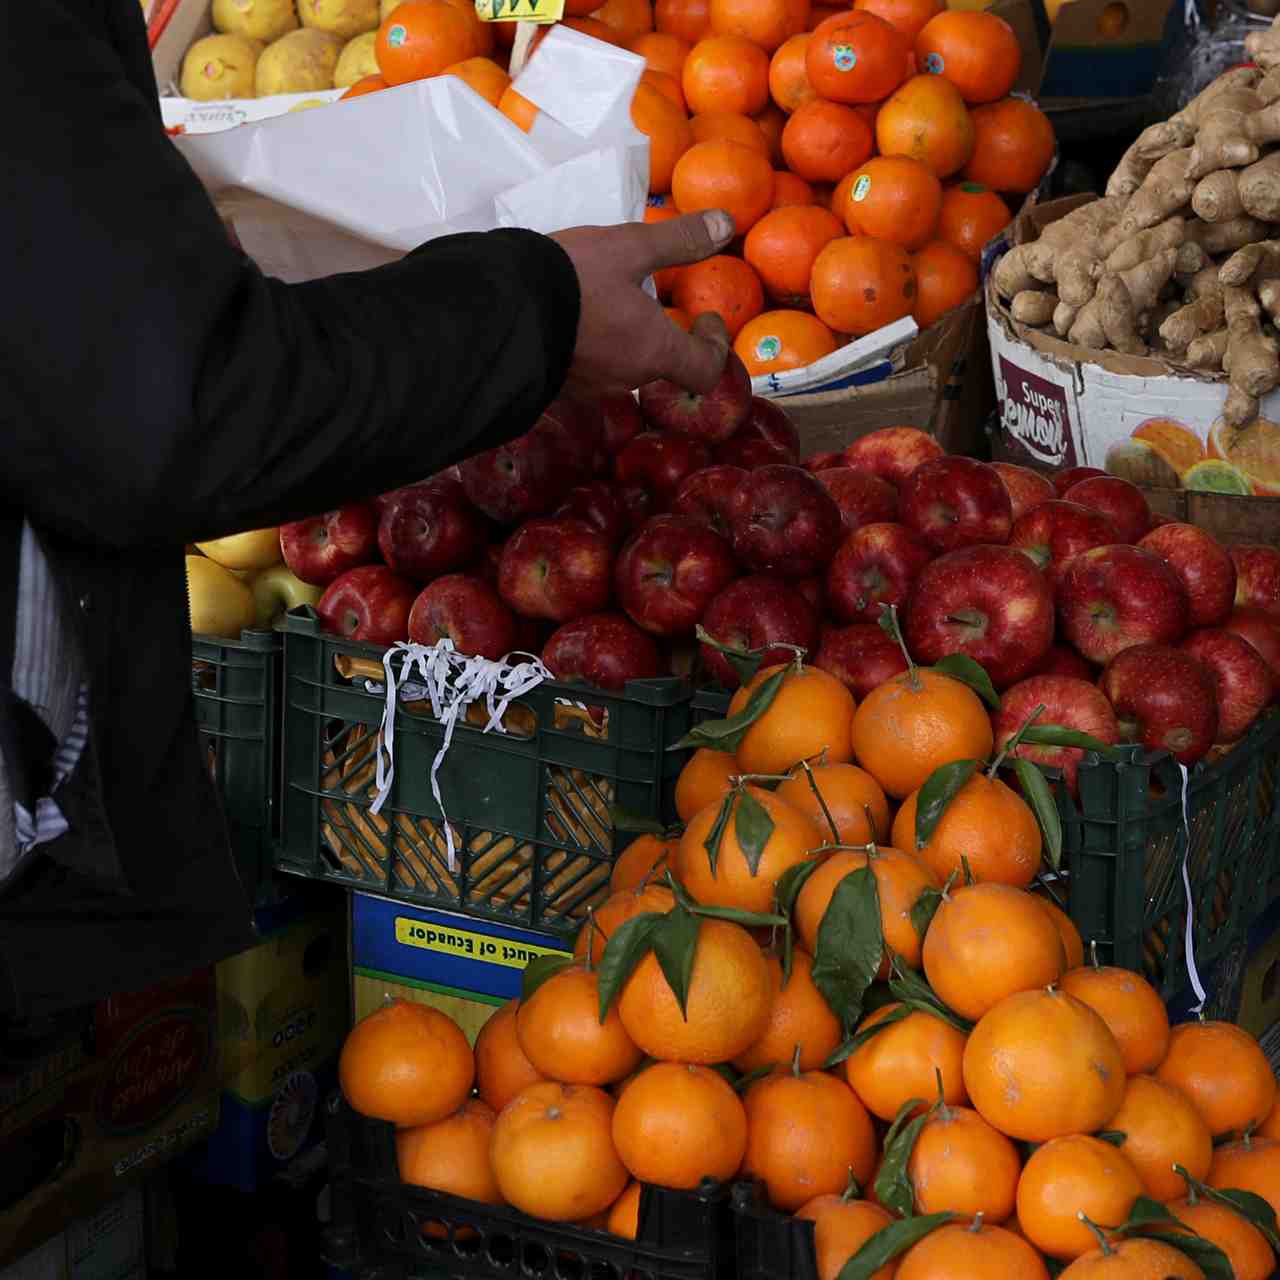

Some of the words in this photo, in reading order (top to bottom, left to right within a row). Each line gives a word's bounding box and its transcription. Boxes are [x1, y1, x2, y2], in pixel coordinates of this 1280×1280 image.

[1022, 381, 1060, 417] Super
[409, 927, 473, 953] Ecuador
[479, 941, 497, 956] of
